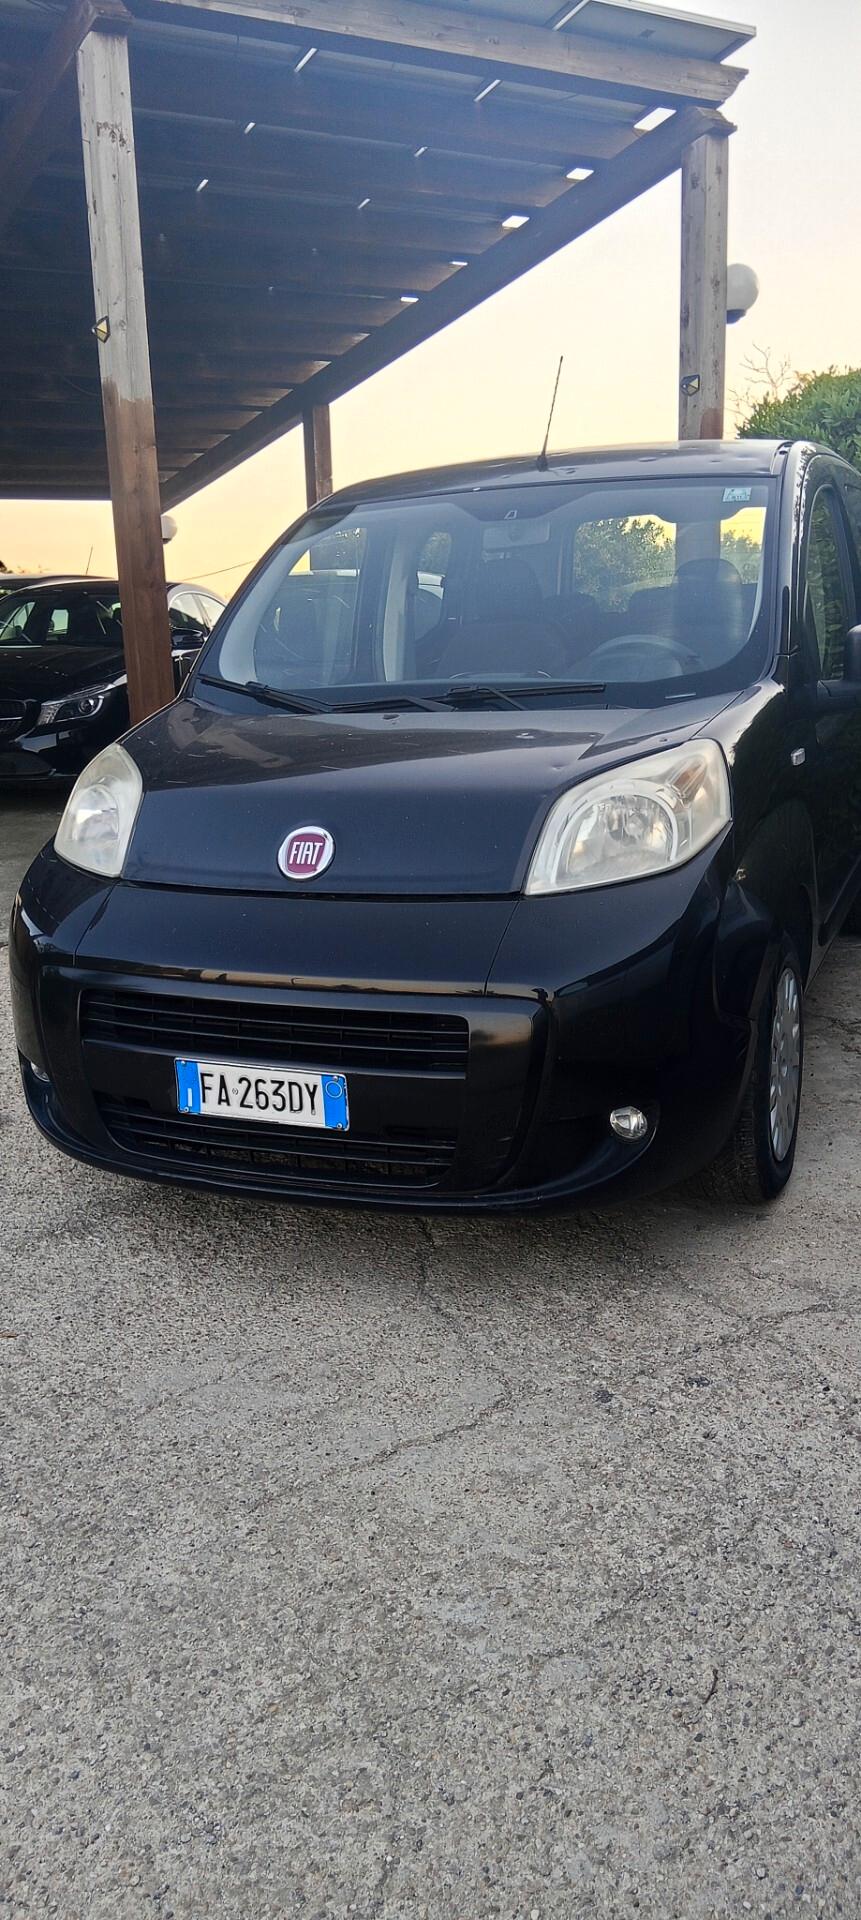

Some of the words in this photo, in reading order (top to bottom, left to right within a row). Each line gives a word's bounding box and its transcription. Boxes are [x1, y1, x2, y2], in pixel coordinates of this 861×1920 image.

[289, 841, 323, 865] FIAT
[200, 1073, 230, 1106] FA
[238, 1077, 318, 1115] 263DY
